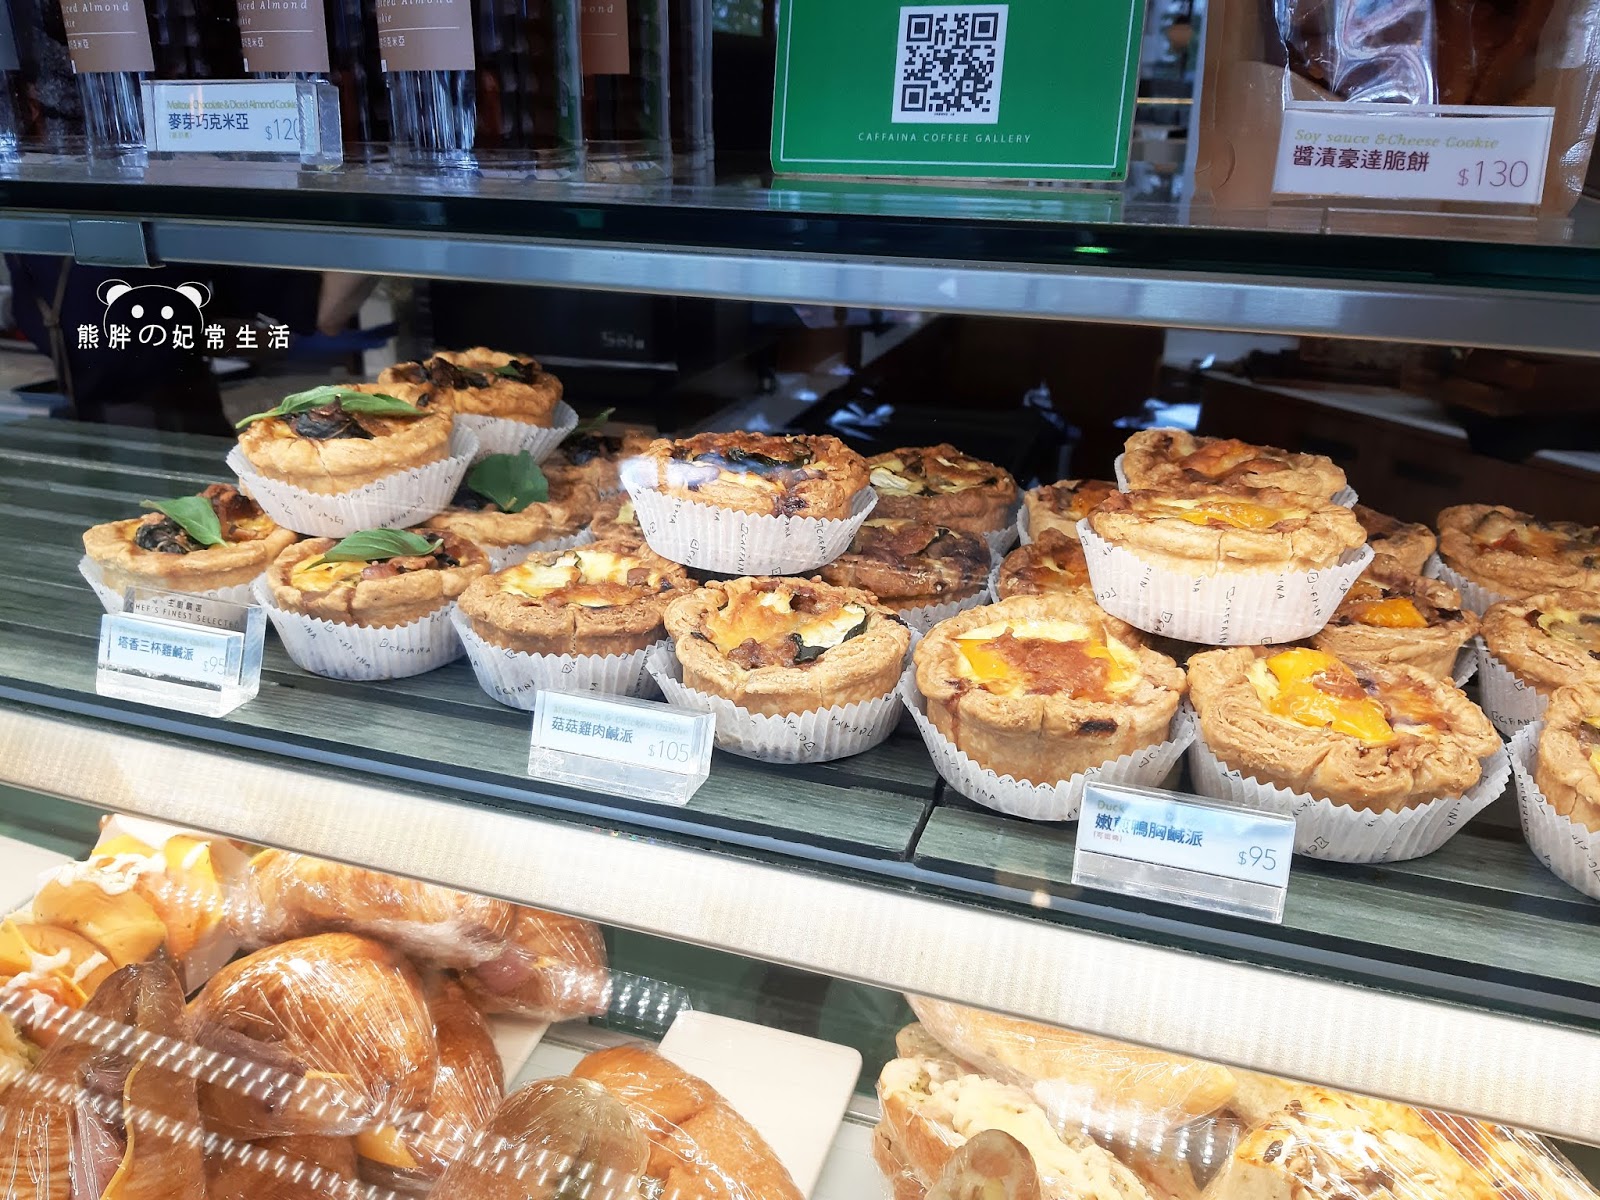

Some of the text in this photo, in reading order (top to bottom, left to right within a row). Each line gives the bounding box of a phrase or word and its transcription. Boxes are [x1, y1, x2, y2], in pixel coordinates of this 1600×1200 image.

[82, 1, 129, 12] Almond
[259, 0, 307, 10] Almond
[168, 113, 250, 130] 麥芽巧克米亞
[858, 132, 1031, 144] CAFFAINA COFFEE GALLERY
[1295, 129, 1322, 145] Soy
[1326, 133, 1370, 145] sauce
[1444, 136, 1500, 150] Cookie
[1292, 145, 1430, 172] 醬漬豪達脆餅
[1457, 159, 1529, 189] $130
[162, 608, 193, 620] FINEST
[117, 635, 194, 661] 塔香三杯雞鹹派
[551, 716, 634, 744] 菇菇雞肉鹹派
[648, 740, 690, 763] $105
[1097, 799, 1125, 813] Duck
[1238, 845, 1278, 871] $95
